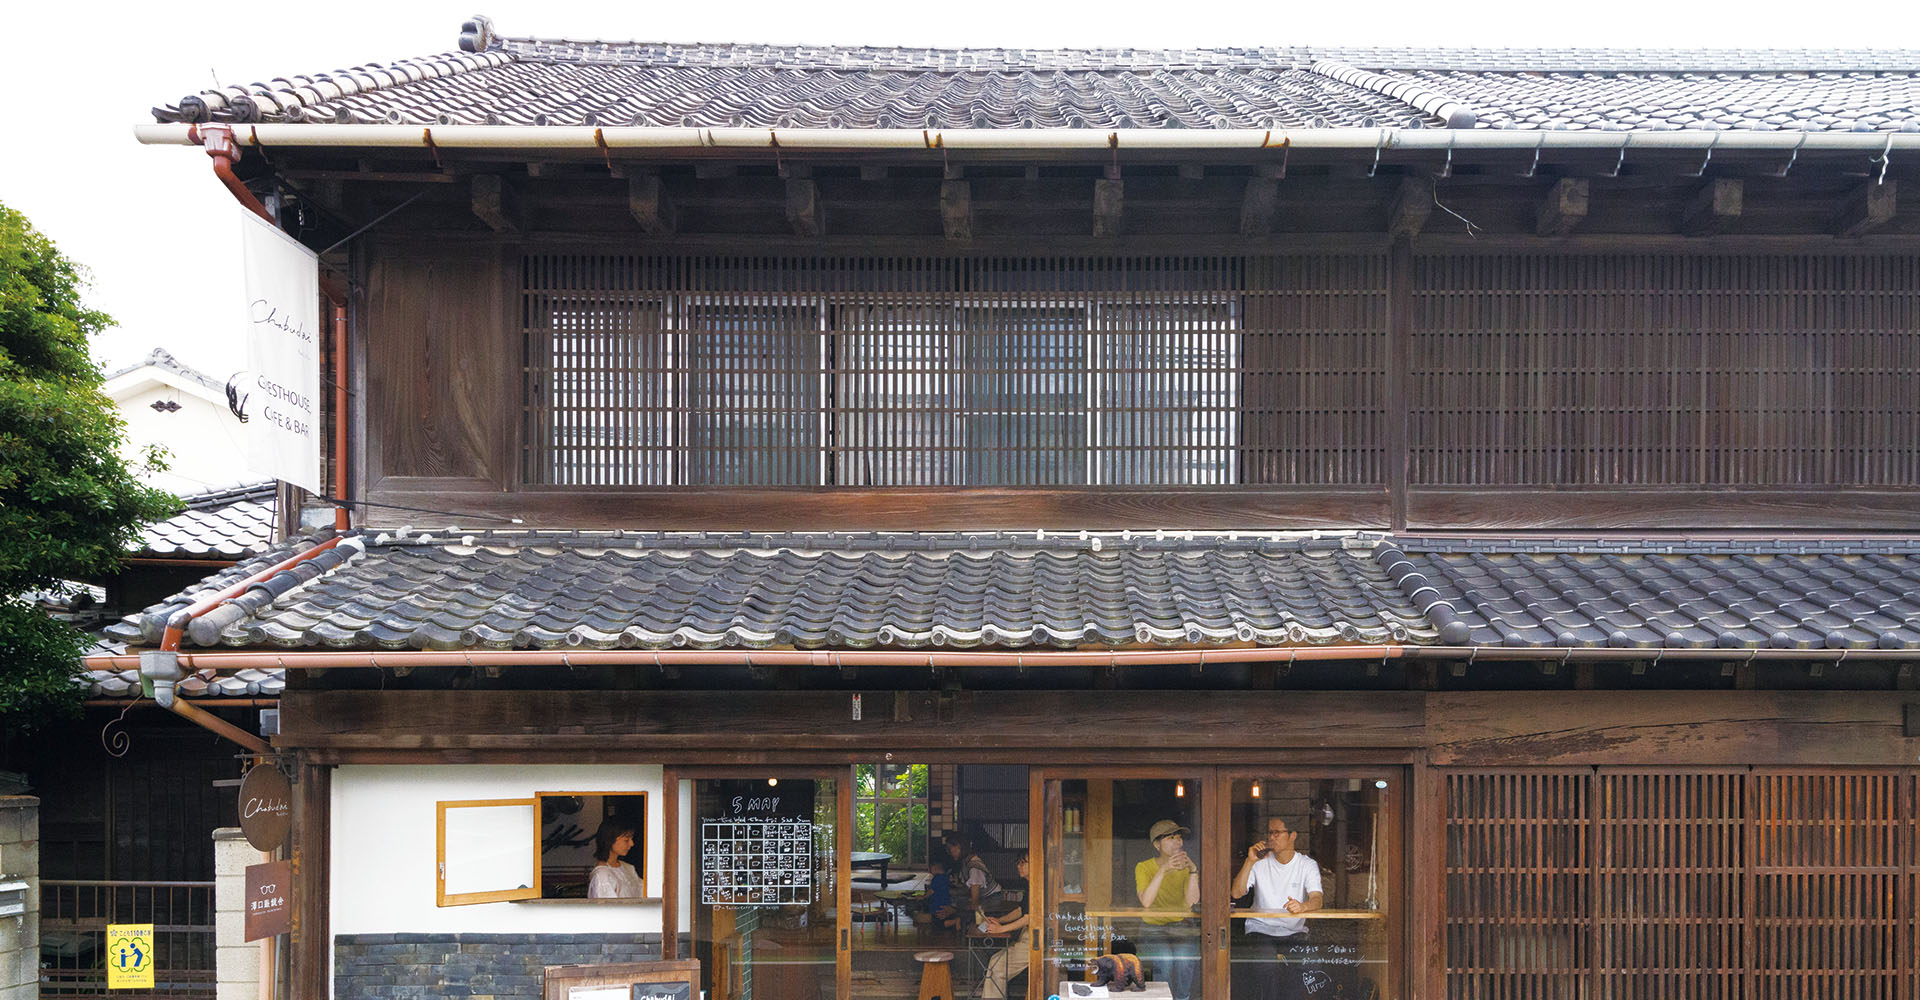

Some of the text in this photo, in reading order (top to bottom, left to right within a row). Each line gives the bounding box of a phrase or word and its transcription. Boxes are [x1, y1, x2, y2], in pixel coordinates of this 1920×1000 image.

[285, 416, 292, 431] &
[732, 796, 780, 814] 5 MAY
